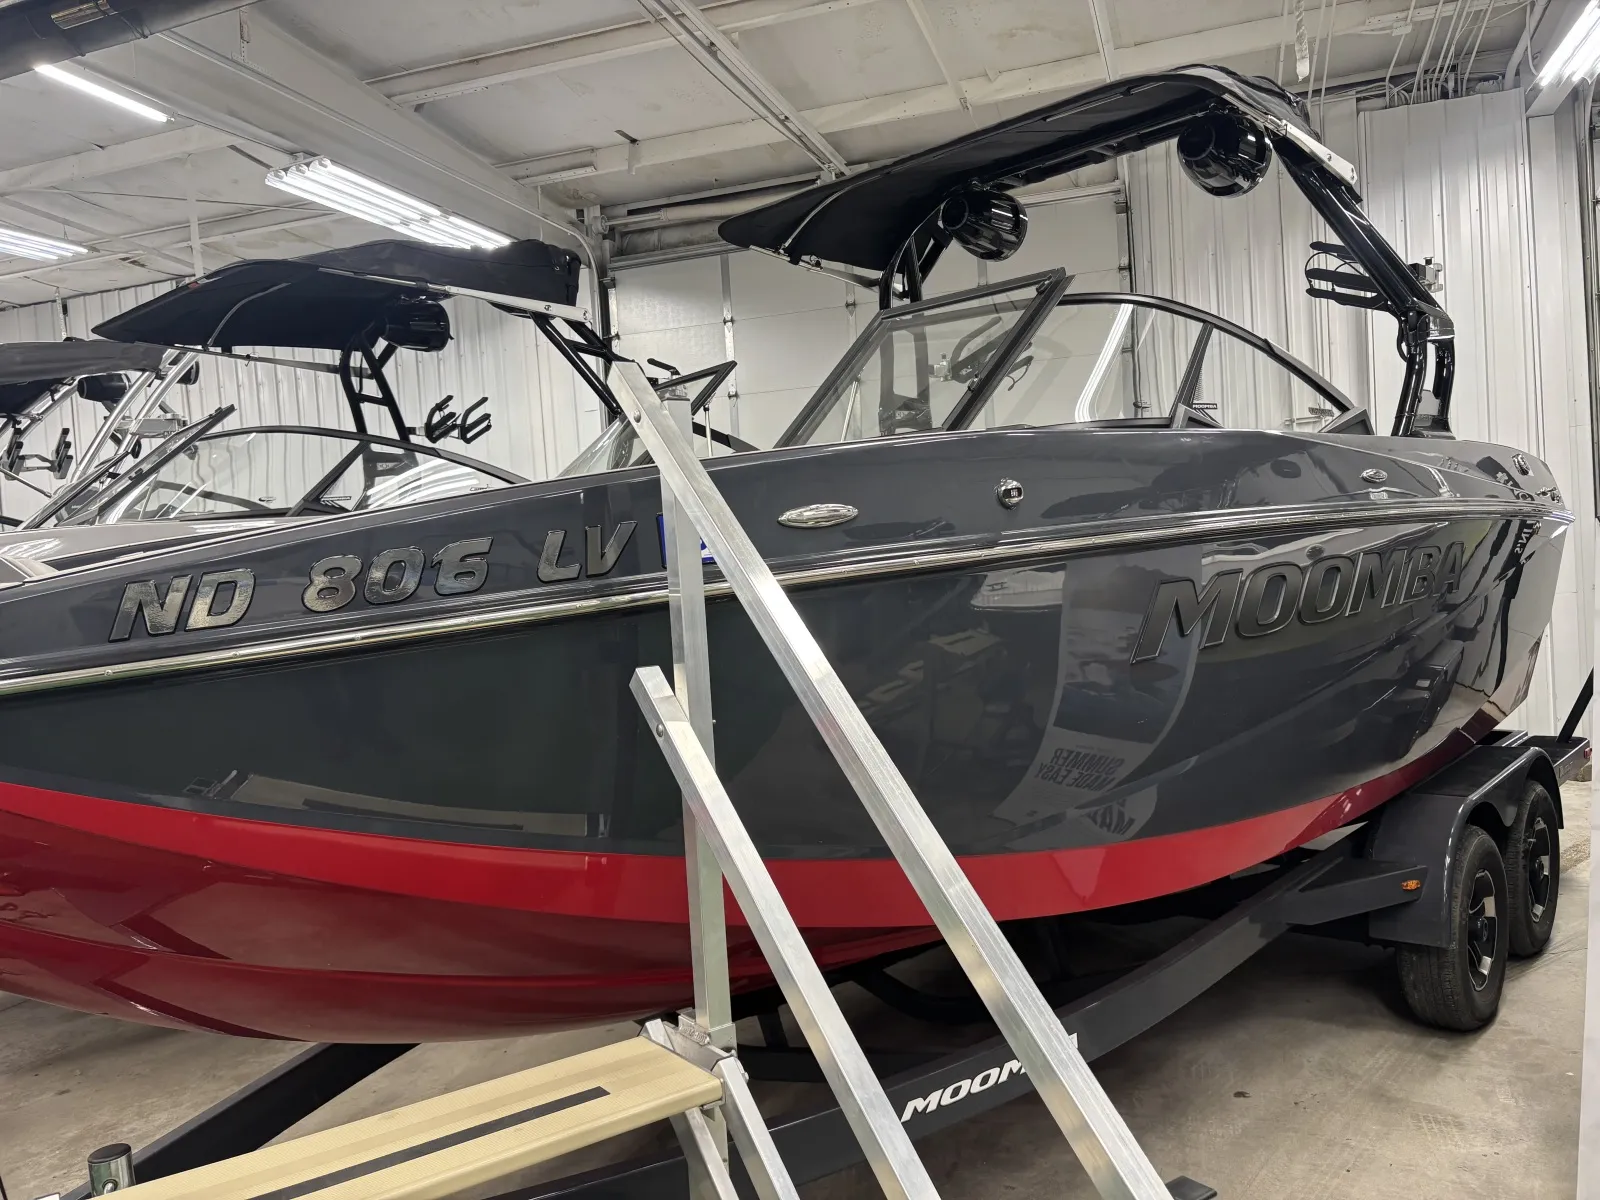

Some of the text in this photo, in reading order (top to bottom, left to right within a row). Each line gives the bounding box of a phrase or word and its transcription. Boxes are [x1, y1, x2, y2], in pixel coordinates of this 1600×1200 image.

[108, 520, 637, 642] ND 806 LV
[1130, 541, 1465, 664] MOOMBA
[900, 1033, 1078, 1123] MOOM
